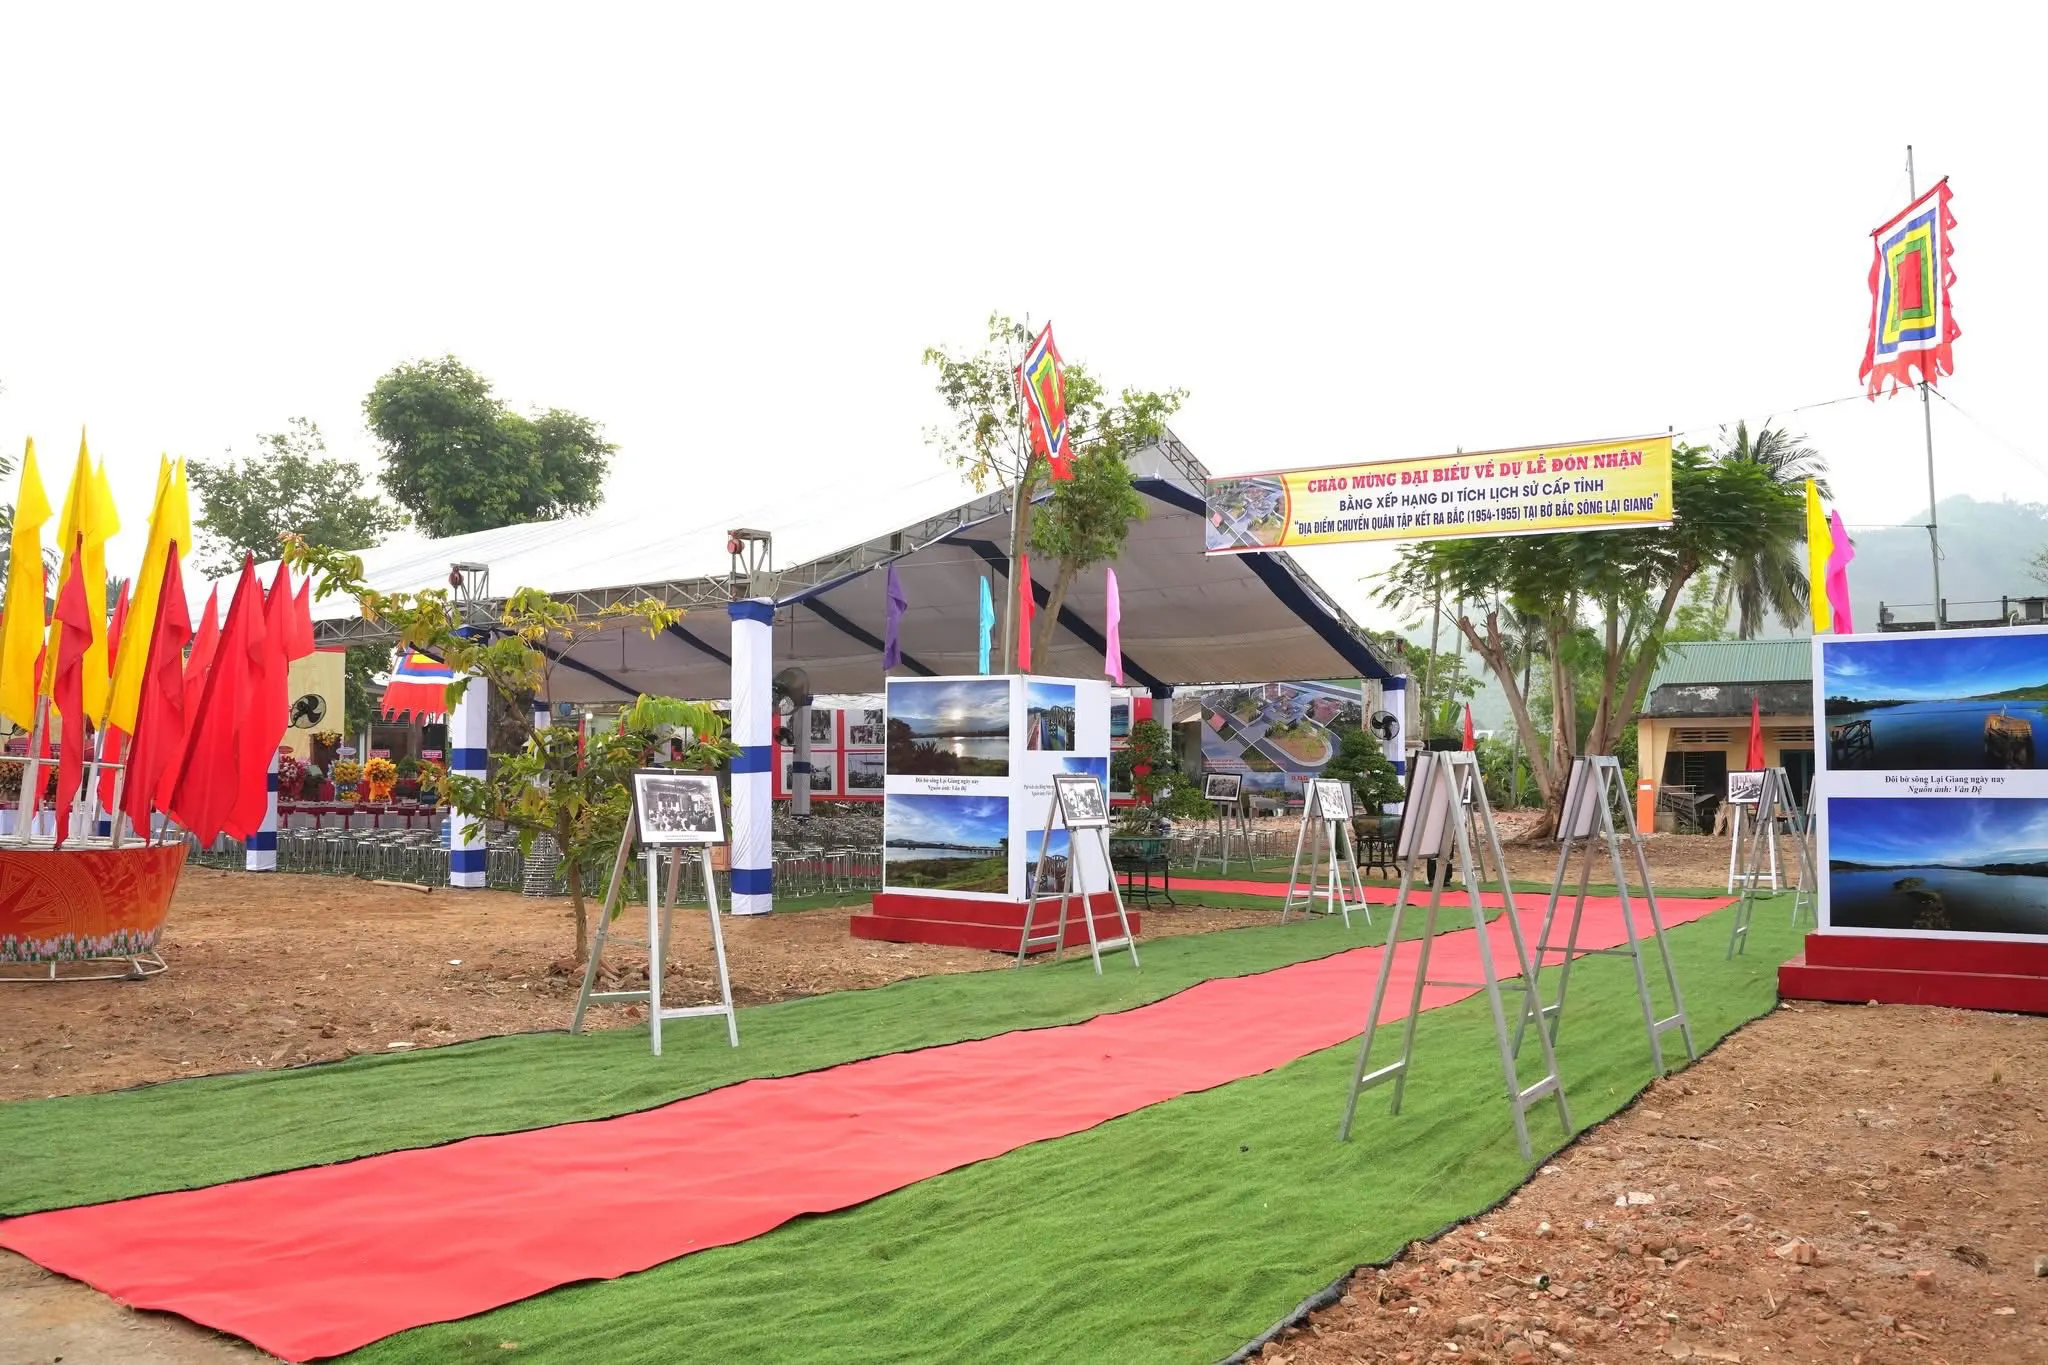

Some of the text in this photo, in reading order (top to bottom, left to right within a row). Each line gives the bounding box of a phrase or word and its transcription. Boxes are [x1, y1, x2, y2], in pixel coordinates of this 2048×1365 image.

[1308, 449, 1643, 493] CHÀO MỪNG ĐẠI BIỂU VỀ DỰ LỄ ĐÓN NHẬN
[1339, 476, 1604, 511] BẰNG XẾP HẠNG DI TÍCH LỊCH SỬ CẤP TỈNH
[1314, 516, 1335, 534] ĐIỂM
[1337, 513, 1369, 532] CHUYỂN
[1371, 513, 1395, 531] QUÂN
[1396, 512, 1413, 530] TẬP
[1415, 509, 1431, 527] KẾT
[1433, 511, 1445, 525] RA
[1447, 506, 1465, 524] BẮC
[1467, 506, 1520, 525] (1954-1955)
[1523, 505, 1538, 521] TẠI
[1540, 501, 1553, 518] BỜ
[1555, 498, 1574, 517] BẮC
[1577, 498, 1603, 516] SÔNG
[1605, 499, 1620, 516] LẠI
[1931, 776, 1943, 784] Lại
[1945, 776, 1968, 784] Giang
[1970, 776, 1989, 784] ngày
